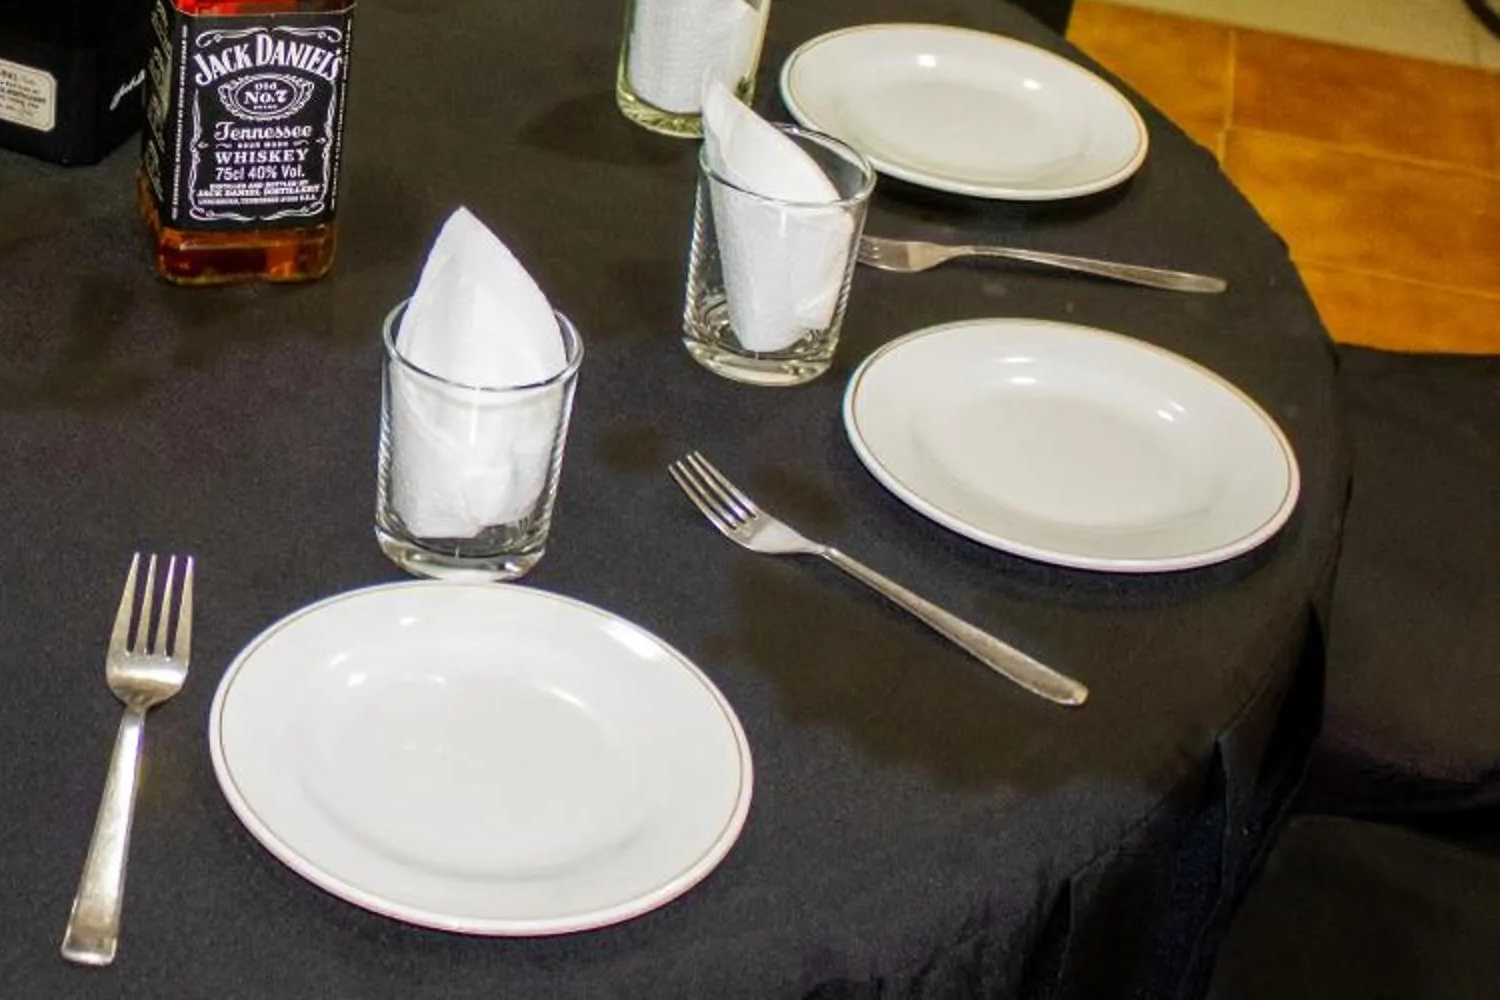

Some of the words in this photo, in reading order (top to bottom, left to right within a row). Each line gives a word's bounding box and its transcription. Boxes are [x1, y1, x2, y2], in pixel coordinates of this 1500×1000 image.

[193, 43, 252, 86] JACK
[255, 33, 342, 81] DANIEL'S
[213, 121, 314, 141] Tennessee
[214, 149, 309, 165] WHISKEY
[215, 166, 245, 181] 75cl
[247, 165, 278, 180] 40%
[281, 163, 306, 179] Vol.
